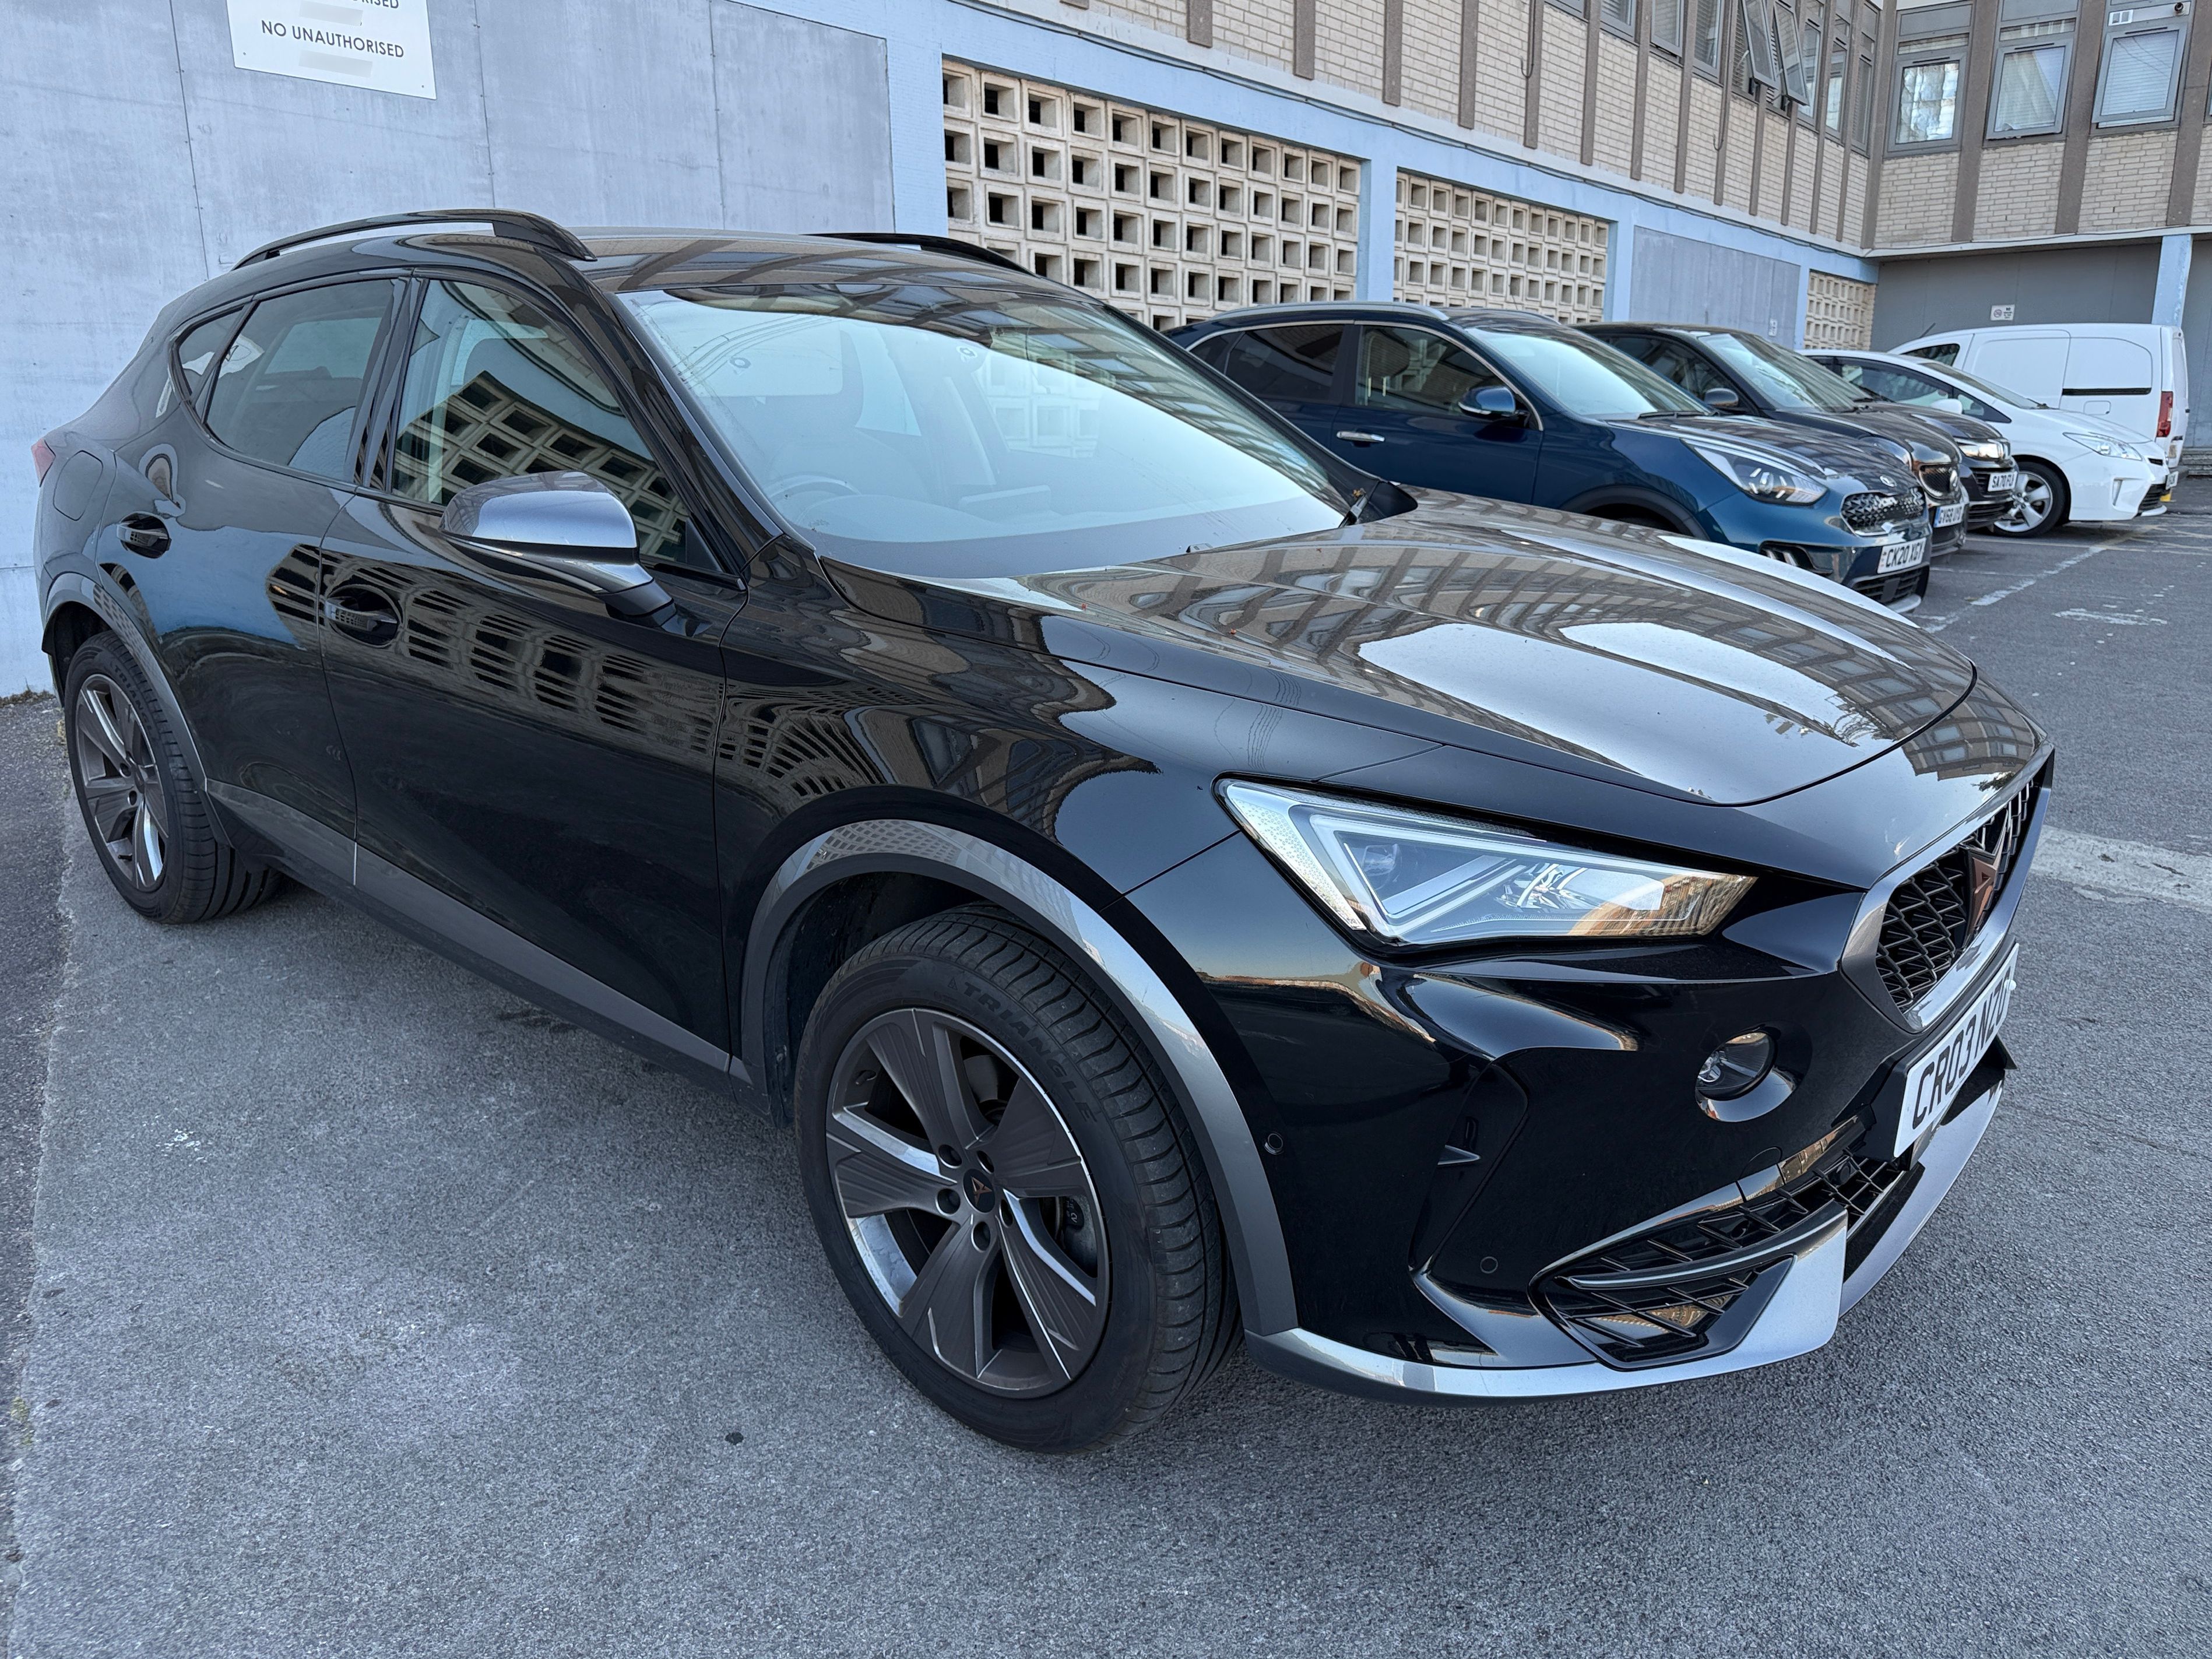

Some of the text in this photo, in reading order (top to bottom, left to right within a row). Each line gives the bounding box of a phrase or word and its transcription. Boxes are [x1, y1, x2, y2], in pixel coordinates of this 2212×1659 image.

[261, 20, 404, 58] NO UNAUTHORISED
[1886, 545, 1909, 568] CK20
[964, 981, 1097, 1122] TRIANGLE
[1912, 1020, 1976, 1129] CR03
